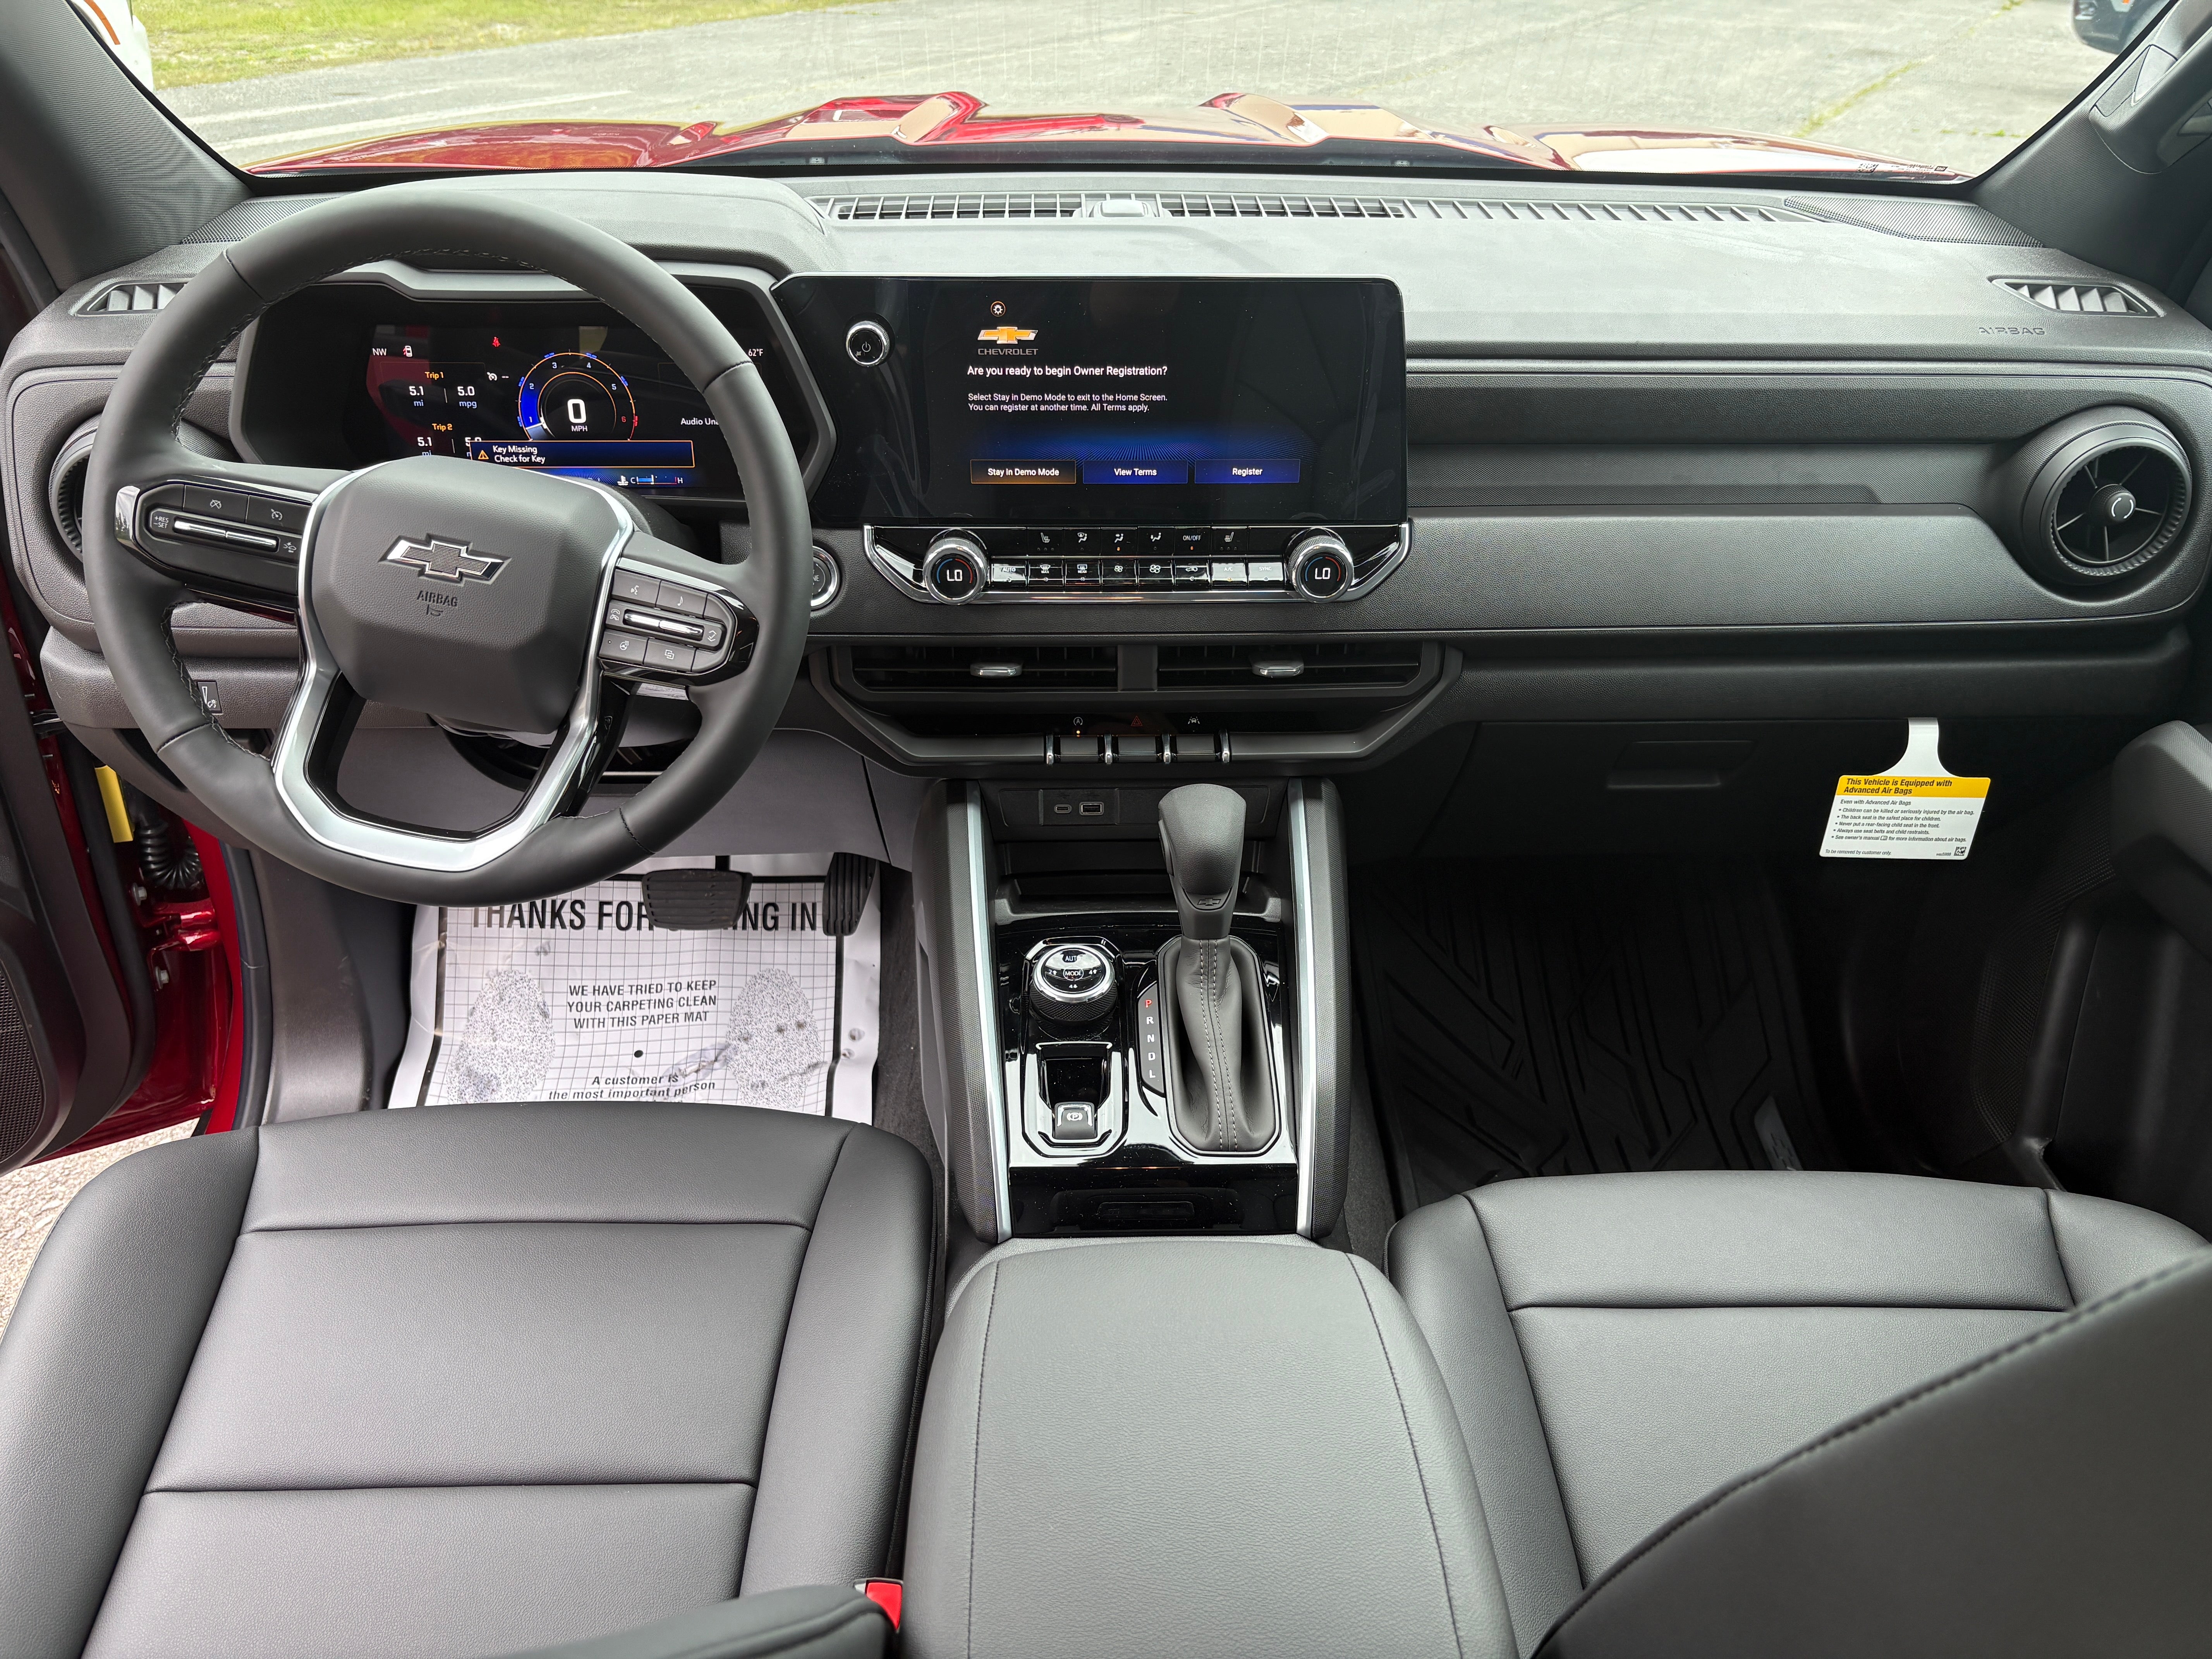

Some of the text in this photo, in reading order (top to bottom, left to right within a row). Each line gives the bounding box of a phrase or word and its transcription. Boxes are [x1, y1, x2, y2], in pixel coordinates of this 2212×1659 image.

[373, 348, 386, 356] NW
[748, 349, 763, 357] 62°F
[424, 371, 440, 380] Trip
[967, 366, 1168, 378] Are you ready to begin Owner Registration?
[409, 386, 424, 395] 5.1
[457, 386, 475, 396] 5.0
[993, 393, 1010, 402] Stay
[567, 399, 586, 423] 0
[1000, 404, 1029, 412] register
[1128, 404, 1149, 412] apply.
[417, 437, 432, 446] 5.1
[493, 445, 538, 454] Key Missing
[531, 455, 545, 464] Key
[988, 468, 1004, 477] Stay
[1232, 468, 1263, 477] Register
[947, 570, 962, 582] LO
[1315, 568, 1331, 579] LO
[417, 590, 458, 606] AIRBAG
[1900, 779, 1935, 787] Equipped
[791, 902, 817, 931] IN
[569, 980, 716, 996] WE HAVE TRIED TO KEEP
[567, 995, 716, 1012] YOUR CARPETING CLEAN
[574, 1011, 709, 1029] WITH THIS PAPER MAT
[1146, 1000, 1156, 1078] P R N D L
[592, 1074, 678, 1085] A customer is
[549, 1083, 715, 1100] the most important person
